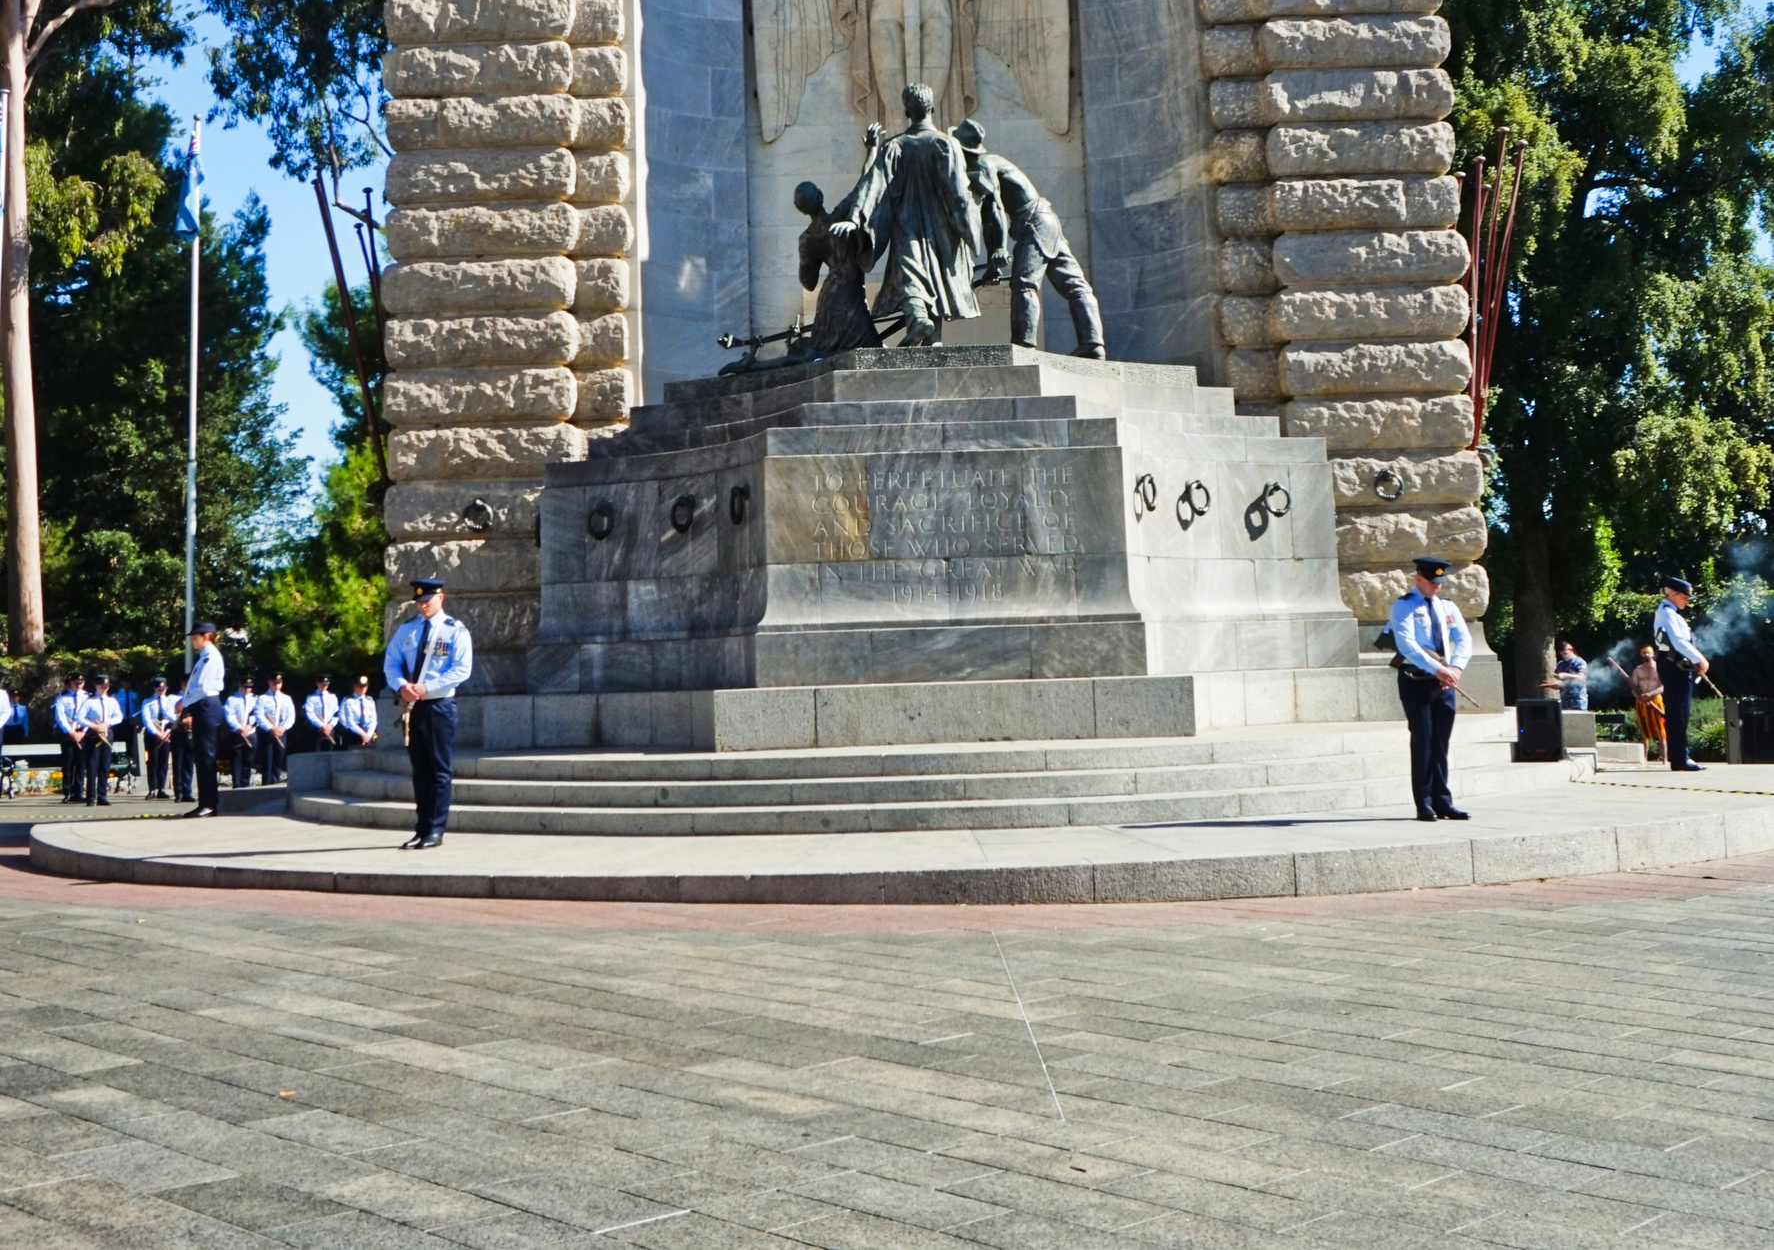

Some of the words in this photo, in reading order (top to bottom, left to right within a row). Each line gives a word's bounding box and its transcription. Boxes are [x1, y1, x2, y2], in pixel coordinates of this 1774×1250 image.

[811, 473, 844, 492] TO
[858, 468, 1012, 490] PERPETUATE
[1028, 466, 1075, 486] THE
[812, 493, 945, 514] COURAGE
[967, 488, 1073, 510] LOYALTY
[813, 517, 872, 538] AND
[886, 513, 1026, 536] SACRIFICE
[1043, 511, 1077, 530] OF
[812, 539, 895, 560] THOSE
[908, 537, 971, 557] WHO
[983, 534, 1080, 554] SERVED
[815, 562, 843, 584] IN
[857, 561, 903, 582] THE
[918, 559, 1006, 581] GREAT
[1017, 554, 1078, 577] WAR
[892, 582, 1004, 606] 1914-1918
